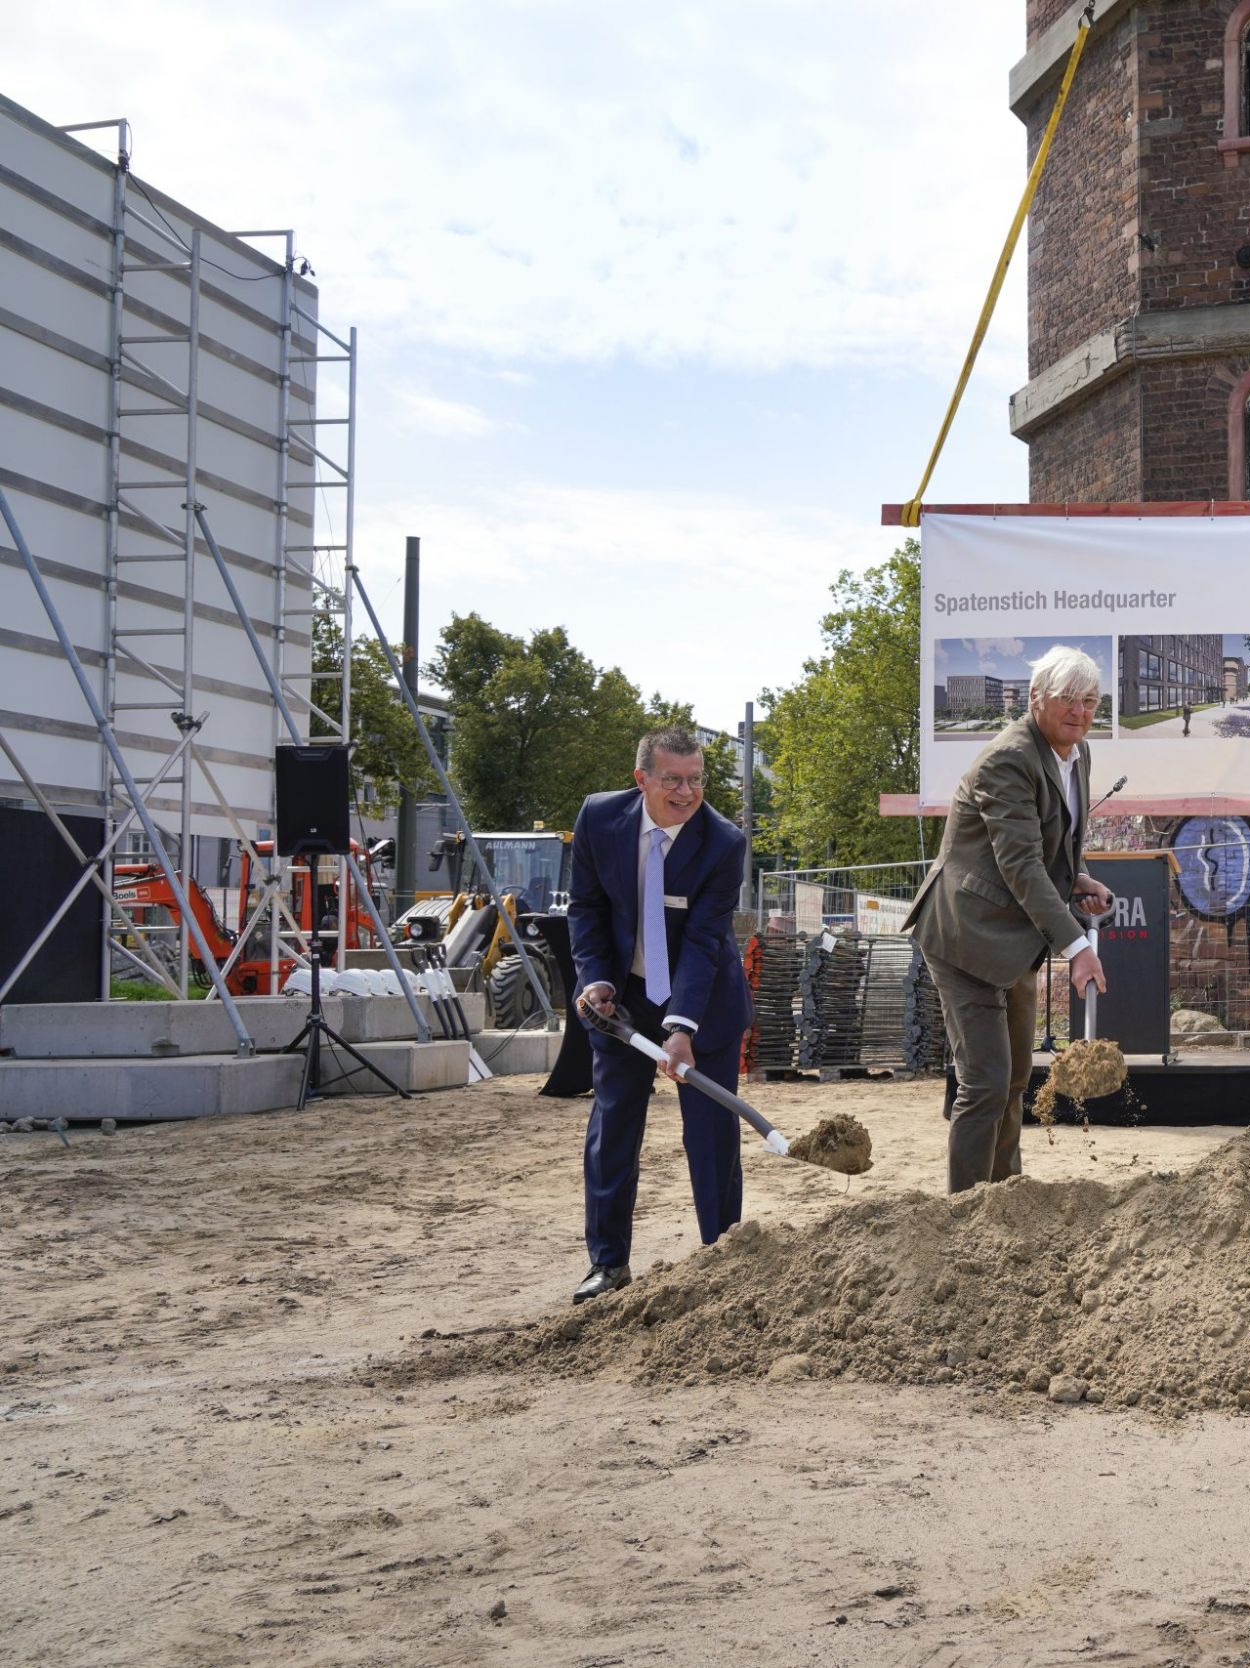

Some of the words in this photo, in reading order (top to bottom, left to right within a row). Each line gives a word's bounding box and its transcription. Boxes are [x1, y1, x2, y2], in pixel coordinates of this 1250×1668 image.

[934, 590, 1047, 616] Spatenstich
[1054, 589, 1177, 613] Headquarter
[485, 840, 536, 850] AHLMANN
[1114, 896, 1147, 928] RA
